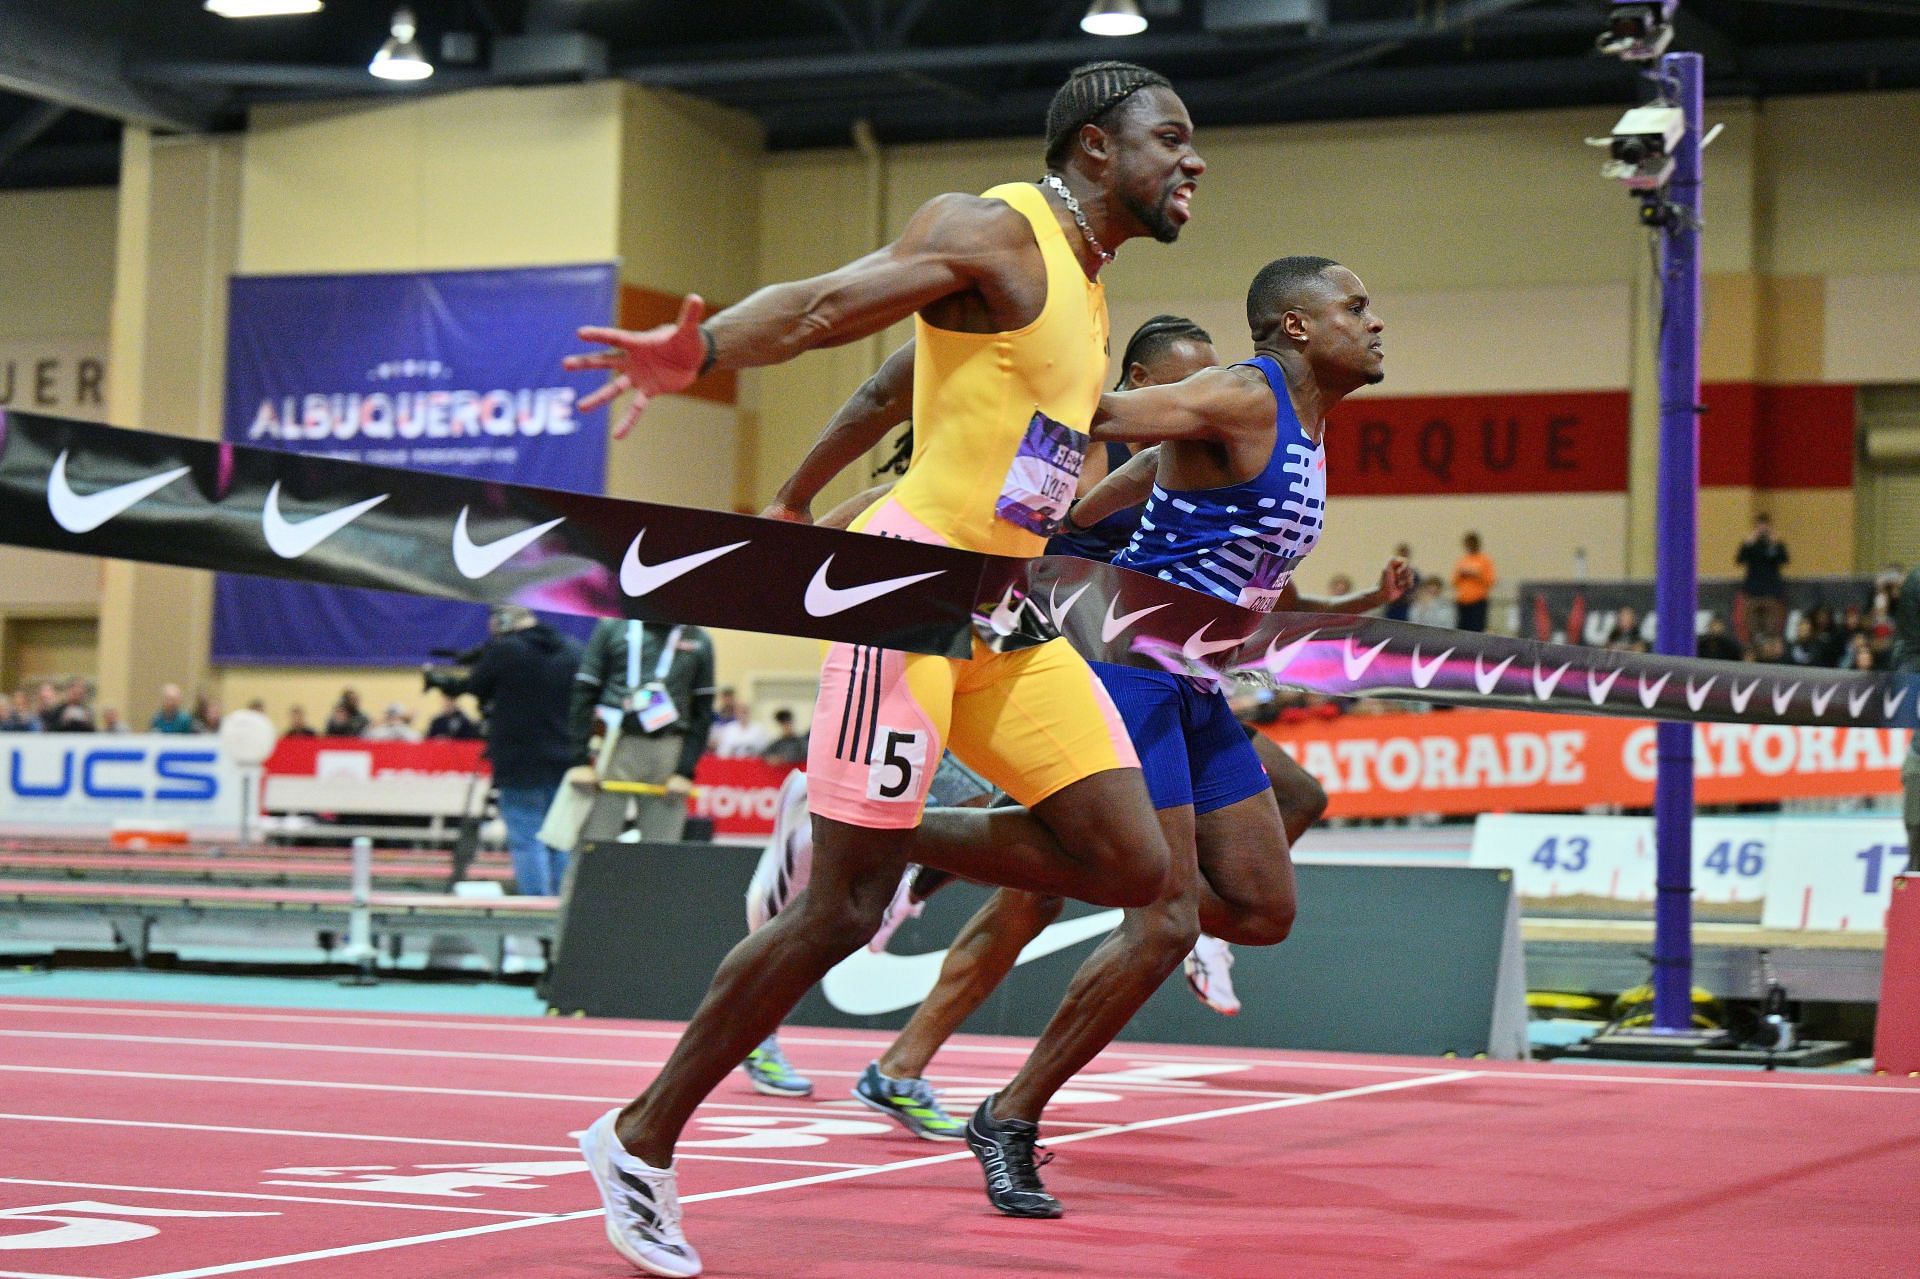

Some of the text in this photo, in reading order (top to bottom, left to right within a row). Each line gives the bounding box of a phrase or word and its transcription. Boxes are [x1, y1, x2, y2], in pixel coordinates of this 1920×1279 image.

[249, 386, 575, 440] ALBUQUERQUE
[1326, 413, 1579, 484] RQUE
[11, 749, 219, 801] UCS
[879, 732, 916, 798] 5
[1531, 835, 1591, 873] 43
[1704, 841, 1766, 877] 46
